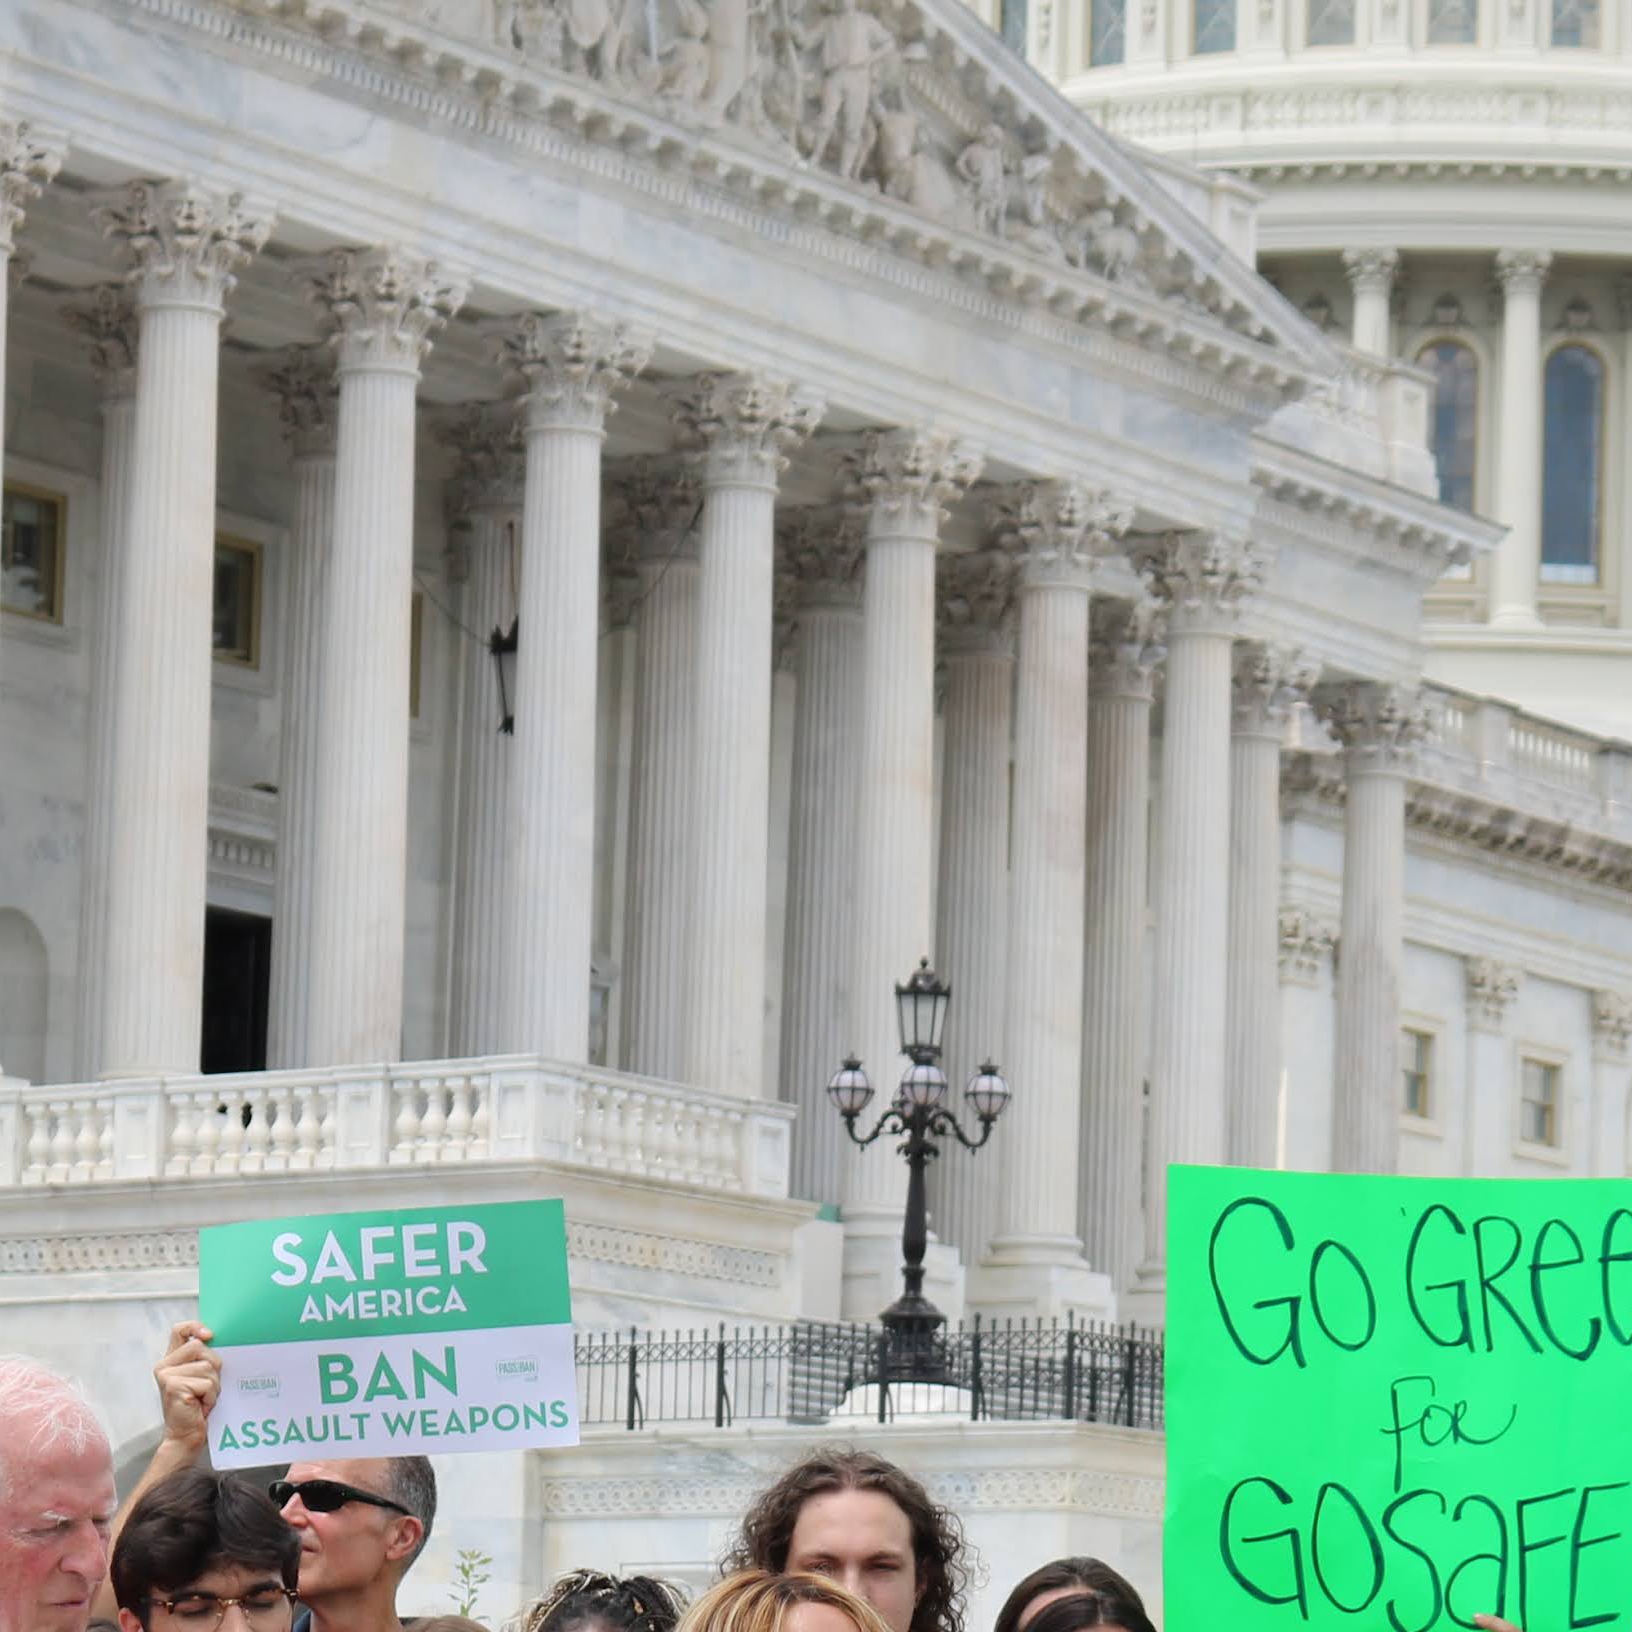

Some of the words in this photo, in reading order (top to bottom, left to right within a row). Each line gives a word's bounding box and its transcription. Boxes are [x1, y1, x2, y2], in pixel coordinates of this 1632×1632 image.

[270, 1220, 488, 1286] SAFER
[299, 1284, 467, 1324] AMERICA
[317, 1346, 459, 1405] BAN
[219, 1411, 370, 1451] ASSAULT
[381, 1400, 568, 1438] WEAPONS
